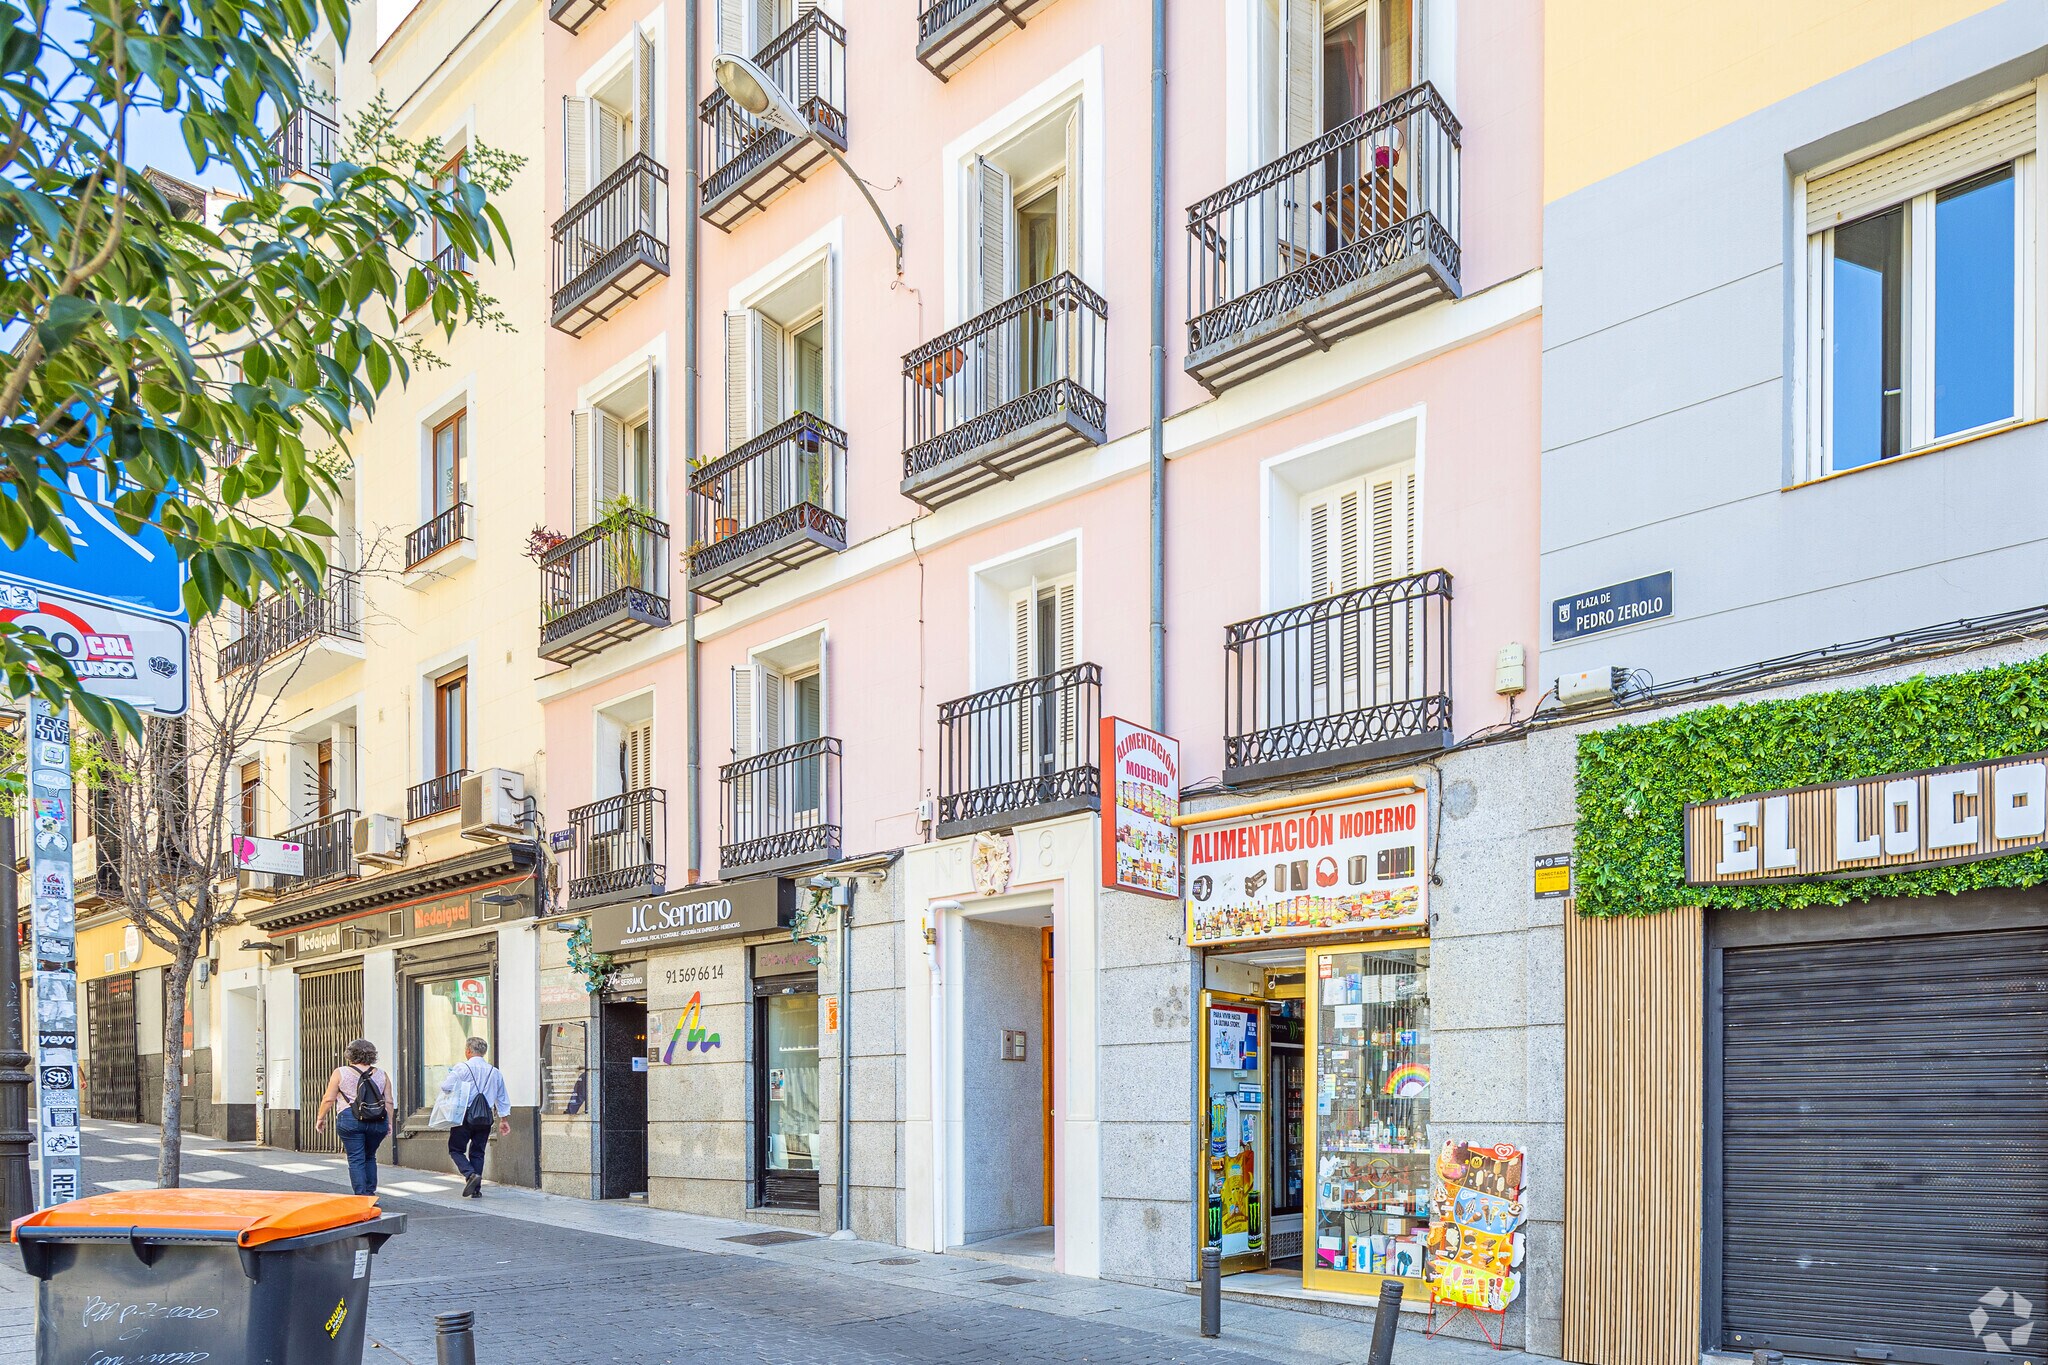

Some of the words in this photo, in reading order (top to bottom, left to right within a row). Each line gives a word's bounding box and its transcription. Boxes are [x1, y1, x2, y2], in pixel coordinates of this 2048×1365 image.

[1576, 596, 1599, 610] PLAZA
[1601, 592, 1611, 603] DE
[1576, 609, 1614, 631] PEDRO
[1618, 597, 1663, 622] ZEROLO
[1117, 733, 1176, 781] ALIMENTACIÓN
[1126, 760, 1168, 788] MODERNO
[1716, 796, 1798, 875] EL
[1836, 763, 2046, 862] LOCO
[1192, 810, 1333, 865] ALIMENTACIÓN
[1340, 804, 1416, 840] MODERNO
[415, 899, 469, 929] Medaigual
[659, 898, 732, 929] Serrano
[298, 928, 340, 952] Medaigual
[621, 977, 643, 986] SERRANO
[666, 970, 677, 984] 91
[679, 968, 697, 983] 569
[697, 966, 710, 981] 66
[712, 964, 724, 979] 14
[40, 1035, 75, 1045] yeyo
[47, 1071, 67, 1083] SB
